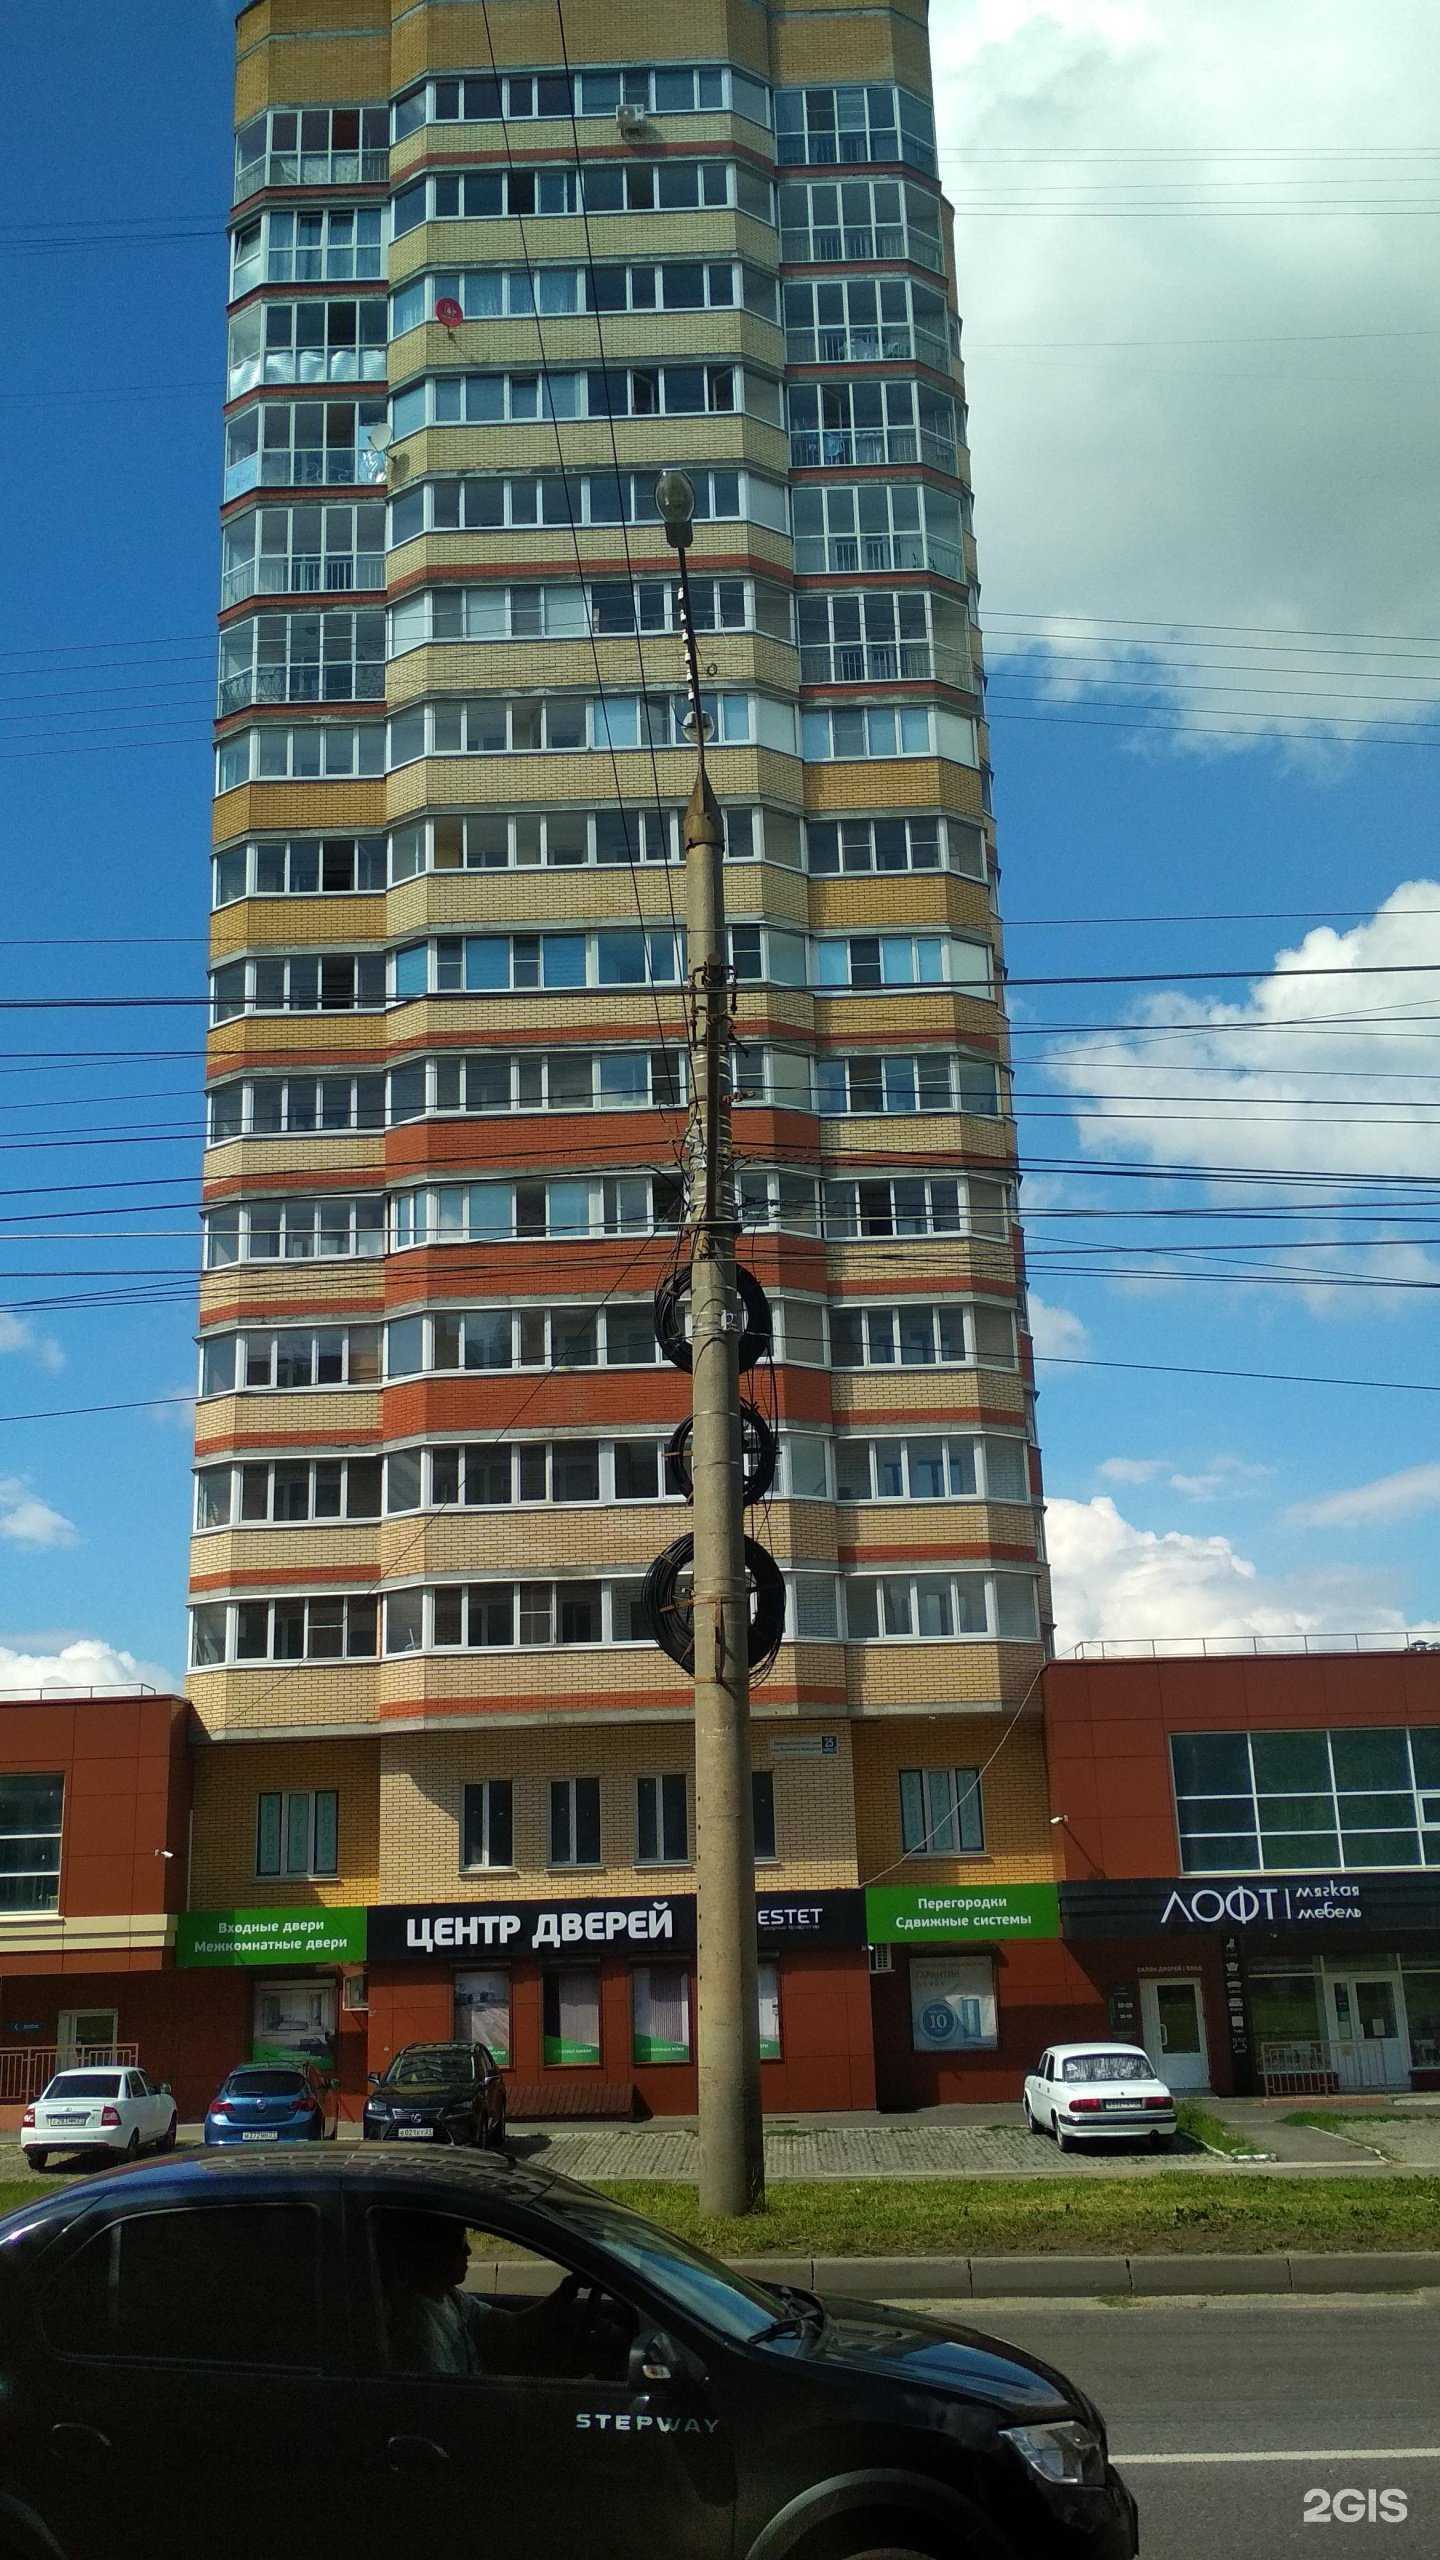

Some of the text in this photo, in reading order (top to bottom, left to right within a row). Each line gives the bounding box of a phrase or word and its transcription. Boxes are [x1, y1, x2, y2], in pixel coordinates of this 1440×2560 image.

[1295, 1880, 1360, 1898] мягкая
[917, 1897, 1007, 1911] Перегородки
[1160, 1885, 1278, 1925] ЛОФТ
[1298, 1901, 1362, 1920] мебель
[757, 1908, 823, 1925] ESTET
[895, 1914, 1032, 1930] Сдвижные системы
[218, 1919, 325, 1934] Входные двери
[406, 1901, 673, 1953] ЦЕНТР ДВЕРЕЙ
[194, 1937, 348, 1953] Межкомнатные двери
[575, 2413, 720, 2433] STEPWAY
